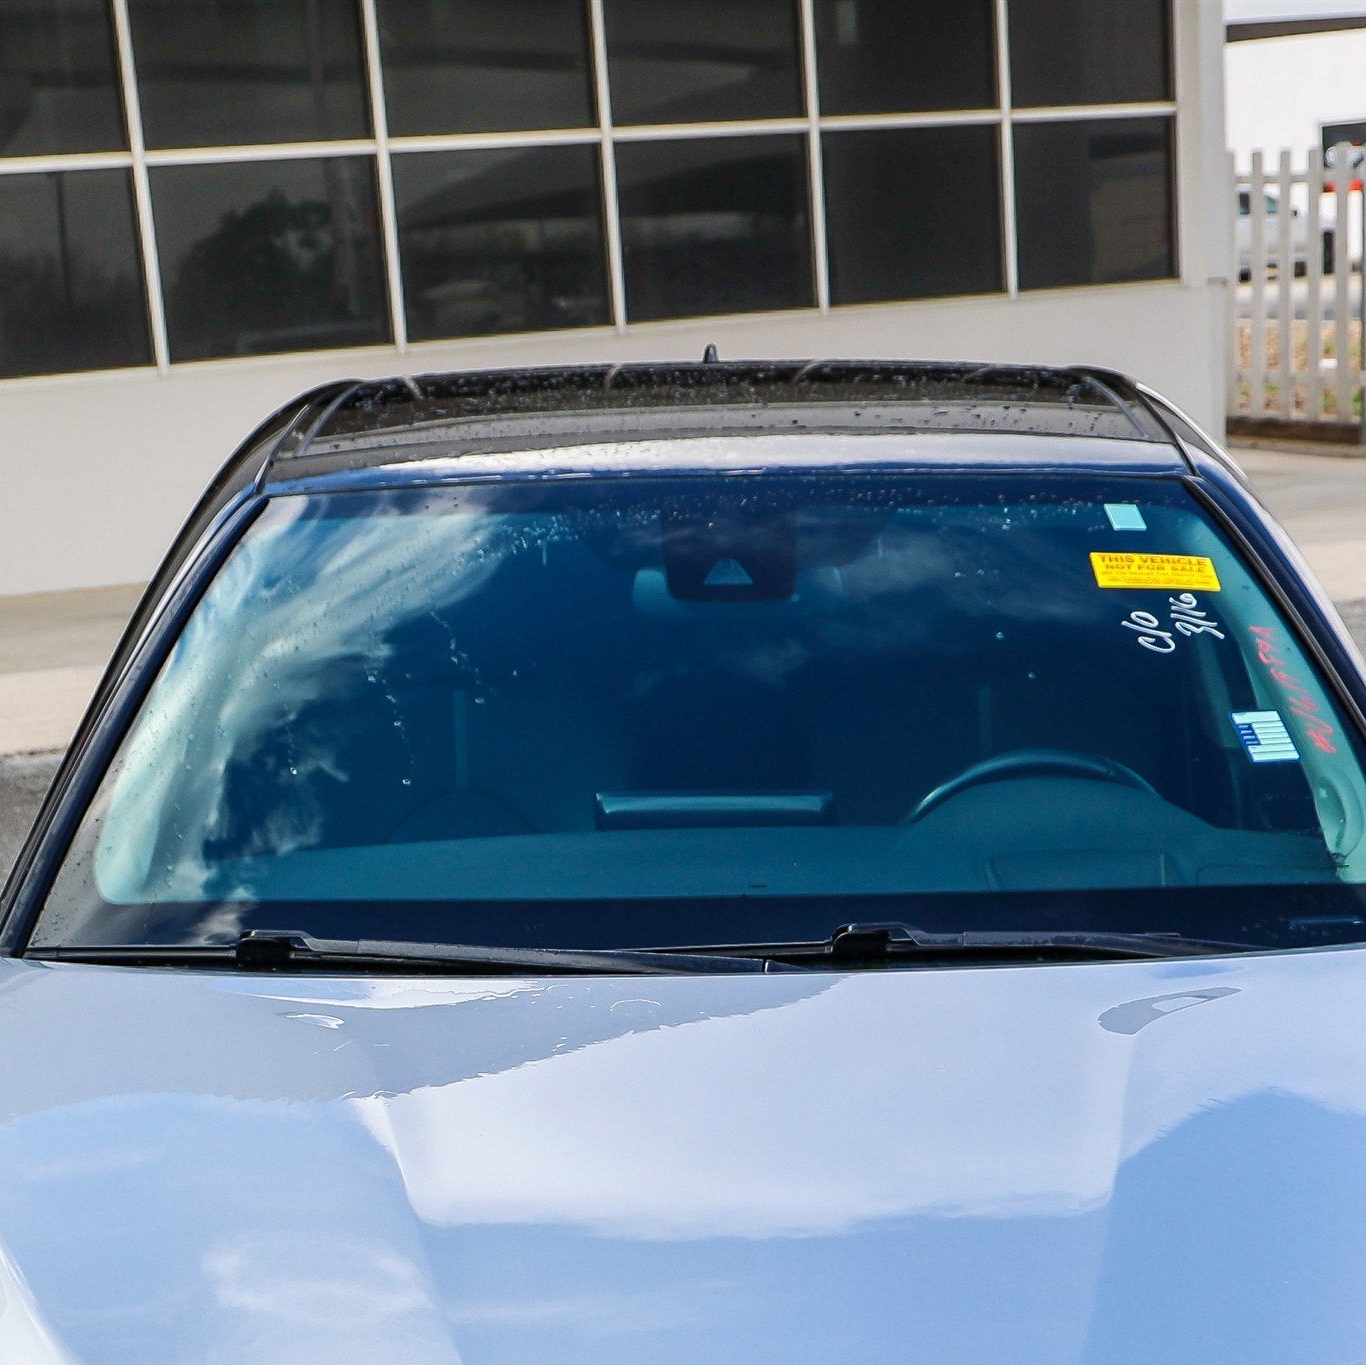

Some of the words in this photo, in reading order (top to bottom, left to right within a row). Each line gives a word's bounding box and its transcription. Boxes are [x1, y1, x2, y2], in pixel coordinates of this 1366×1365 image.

[1098, 554, 1135, 564] THIS
[1139, 556, 1207, 567] VEHICLE
[1105, 563, 1132, 571] NOT
[1137, 564, 1166, 572] FOR
[1170, 565, 1206, 574] SALE
